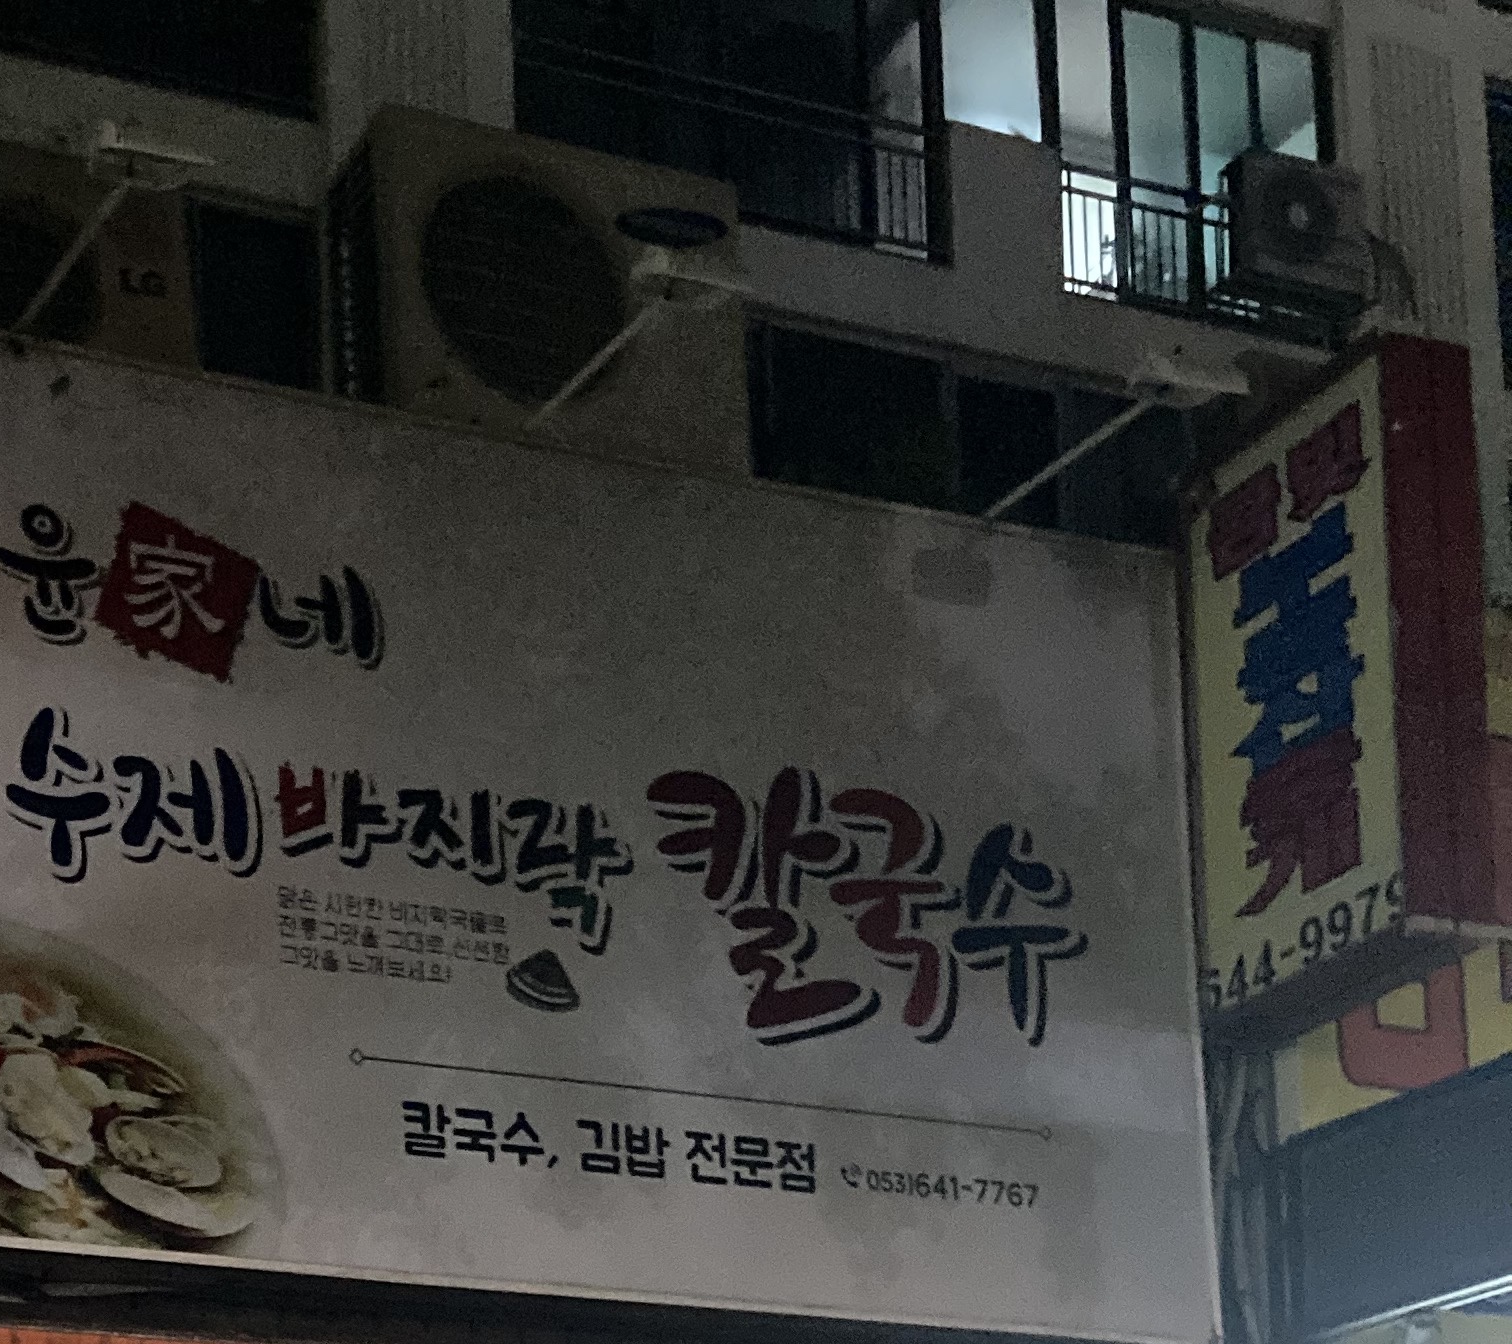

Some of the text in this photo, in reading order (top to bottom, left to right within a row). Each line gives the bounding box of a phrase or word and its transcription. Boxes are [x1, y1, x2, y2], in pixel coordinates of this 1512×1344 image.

[118, 267, 169, 299] LG
[5, 706, 1090, 1048] 수제 바지락 칼국수
[400, 1098, 560, 1172] 칼국수,
[574, 1116, 670, 1178] 김밥
[683, 1128, 819, 1193] 전문점
